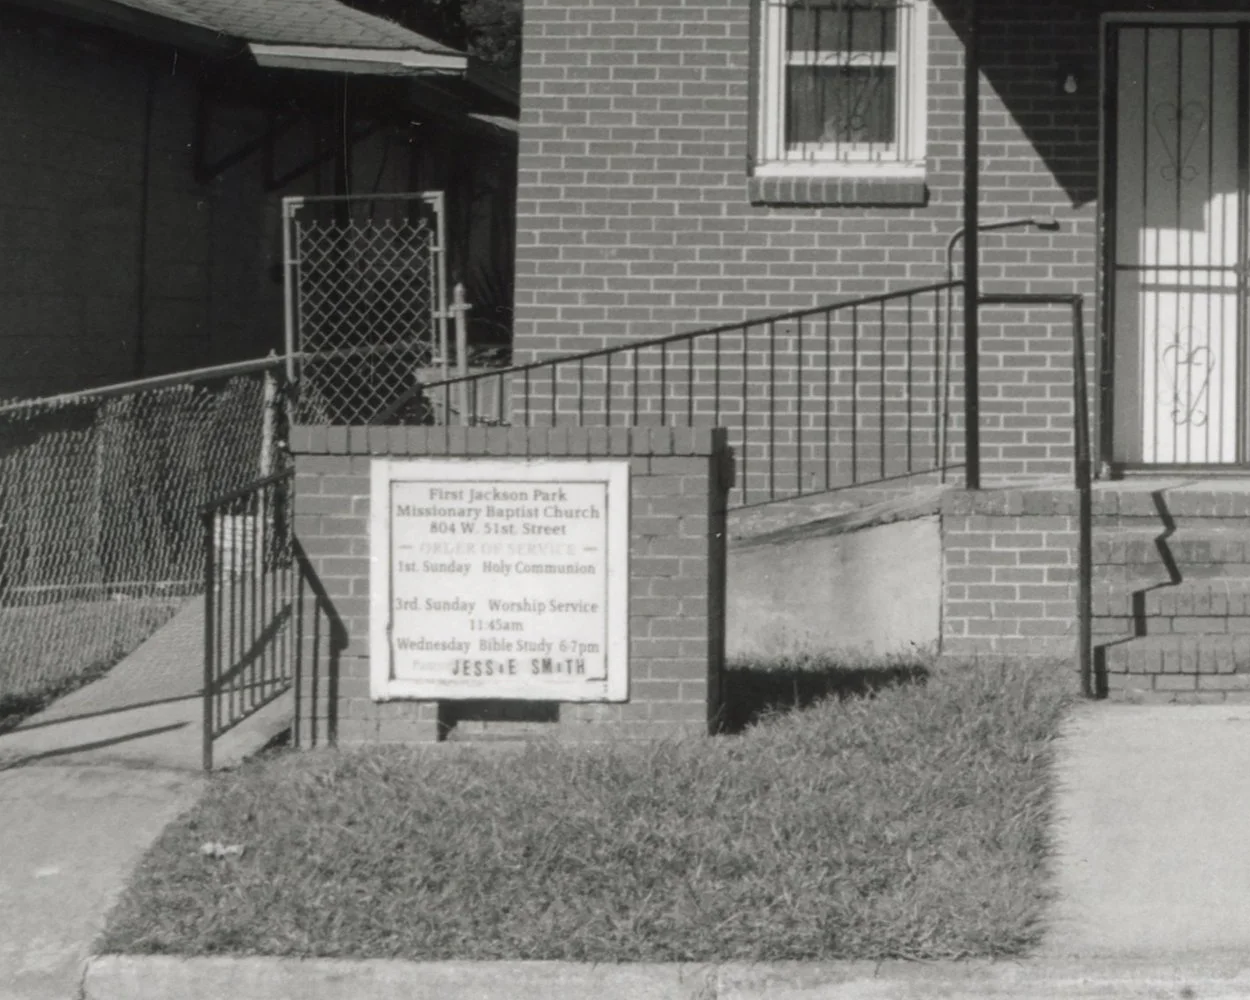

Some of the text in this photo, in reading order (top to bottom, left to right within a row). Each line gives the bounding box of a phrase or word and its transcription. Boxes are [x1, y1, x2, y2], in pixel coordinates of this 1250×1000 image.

[429, 487, 567, 504] First Jackson Park
[396, 504, 600, 520] Missionary Baptist Church
[429, 521, 456, 535] 804
[522, 522, 567, 536] Street
[507, 543, 576, 557] SERVICE
[422, 559, 472, 576] Sunday
[482, 559, 511, 577] Holy
[514, 560, 597, 575] Communion
[425, 596, 476, 615] Sunday
[488, 597, 547, 616] Worship
[548, 599, 600, 613] Service
[469, 618, 524, 632] 11:45am
[396, 635, 471, 655] Wednesday
[479, 636, 513, 652] Bible
[515, 636, 553, 656] Study
